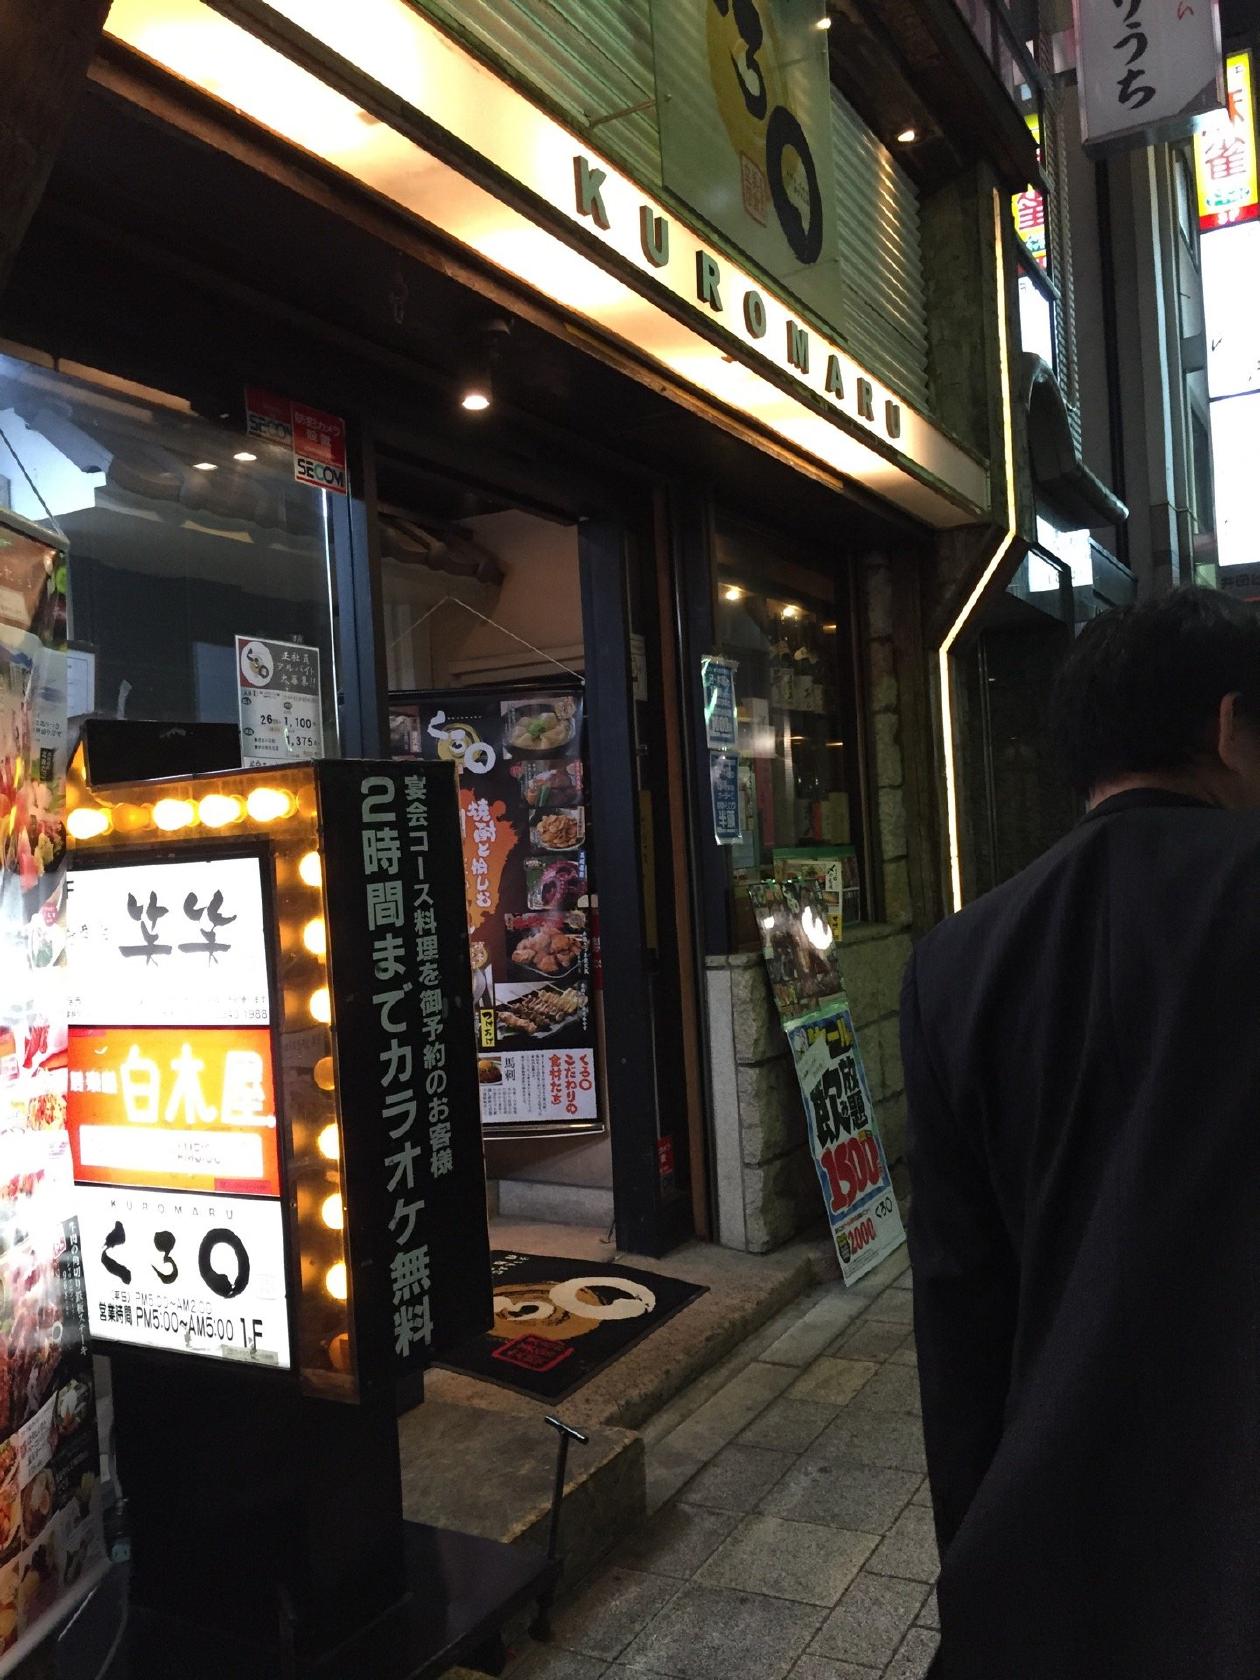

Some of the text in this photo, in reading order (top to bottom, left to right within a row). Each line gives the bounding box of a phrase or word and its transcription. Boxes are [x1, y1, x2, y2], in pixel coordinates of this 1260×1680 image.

[573, 155, 901, 439] KUROMARU
[297, 459, 344, 487] SECOM
[403, 774, 454, 1179] 宴会コース料理を御予約のお客様
[119, 1042, 276, 1128] 白木屋
[360, 776, 434, 1358] 2時間までカラオケ無料
[111, 1199, 234, 1220] KUROMARU
[98, 1301, 133, 1326] 営業時間
